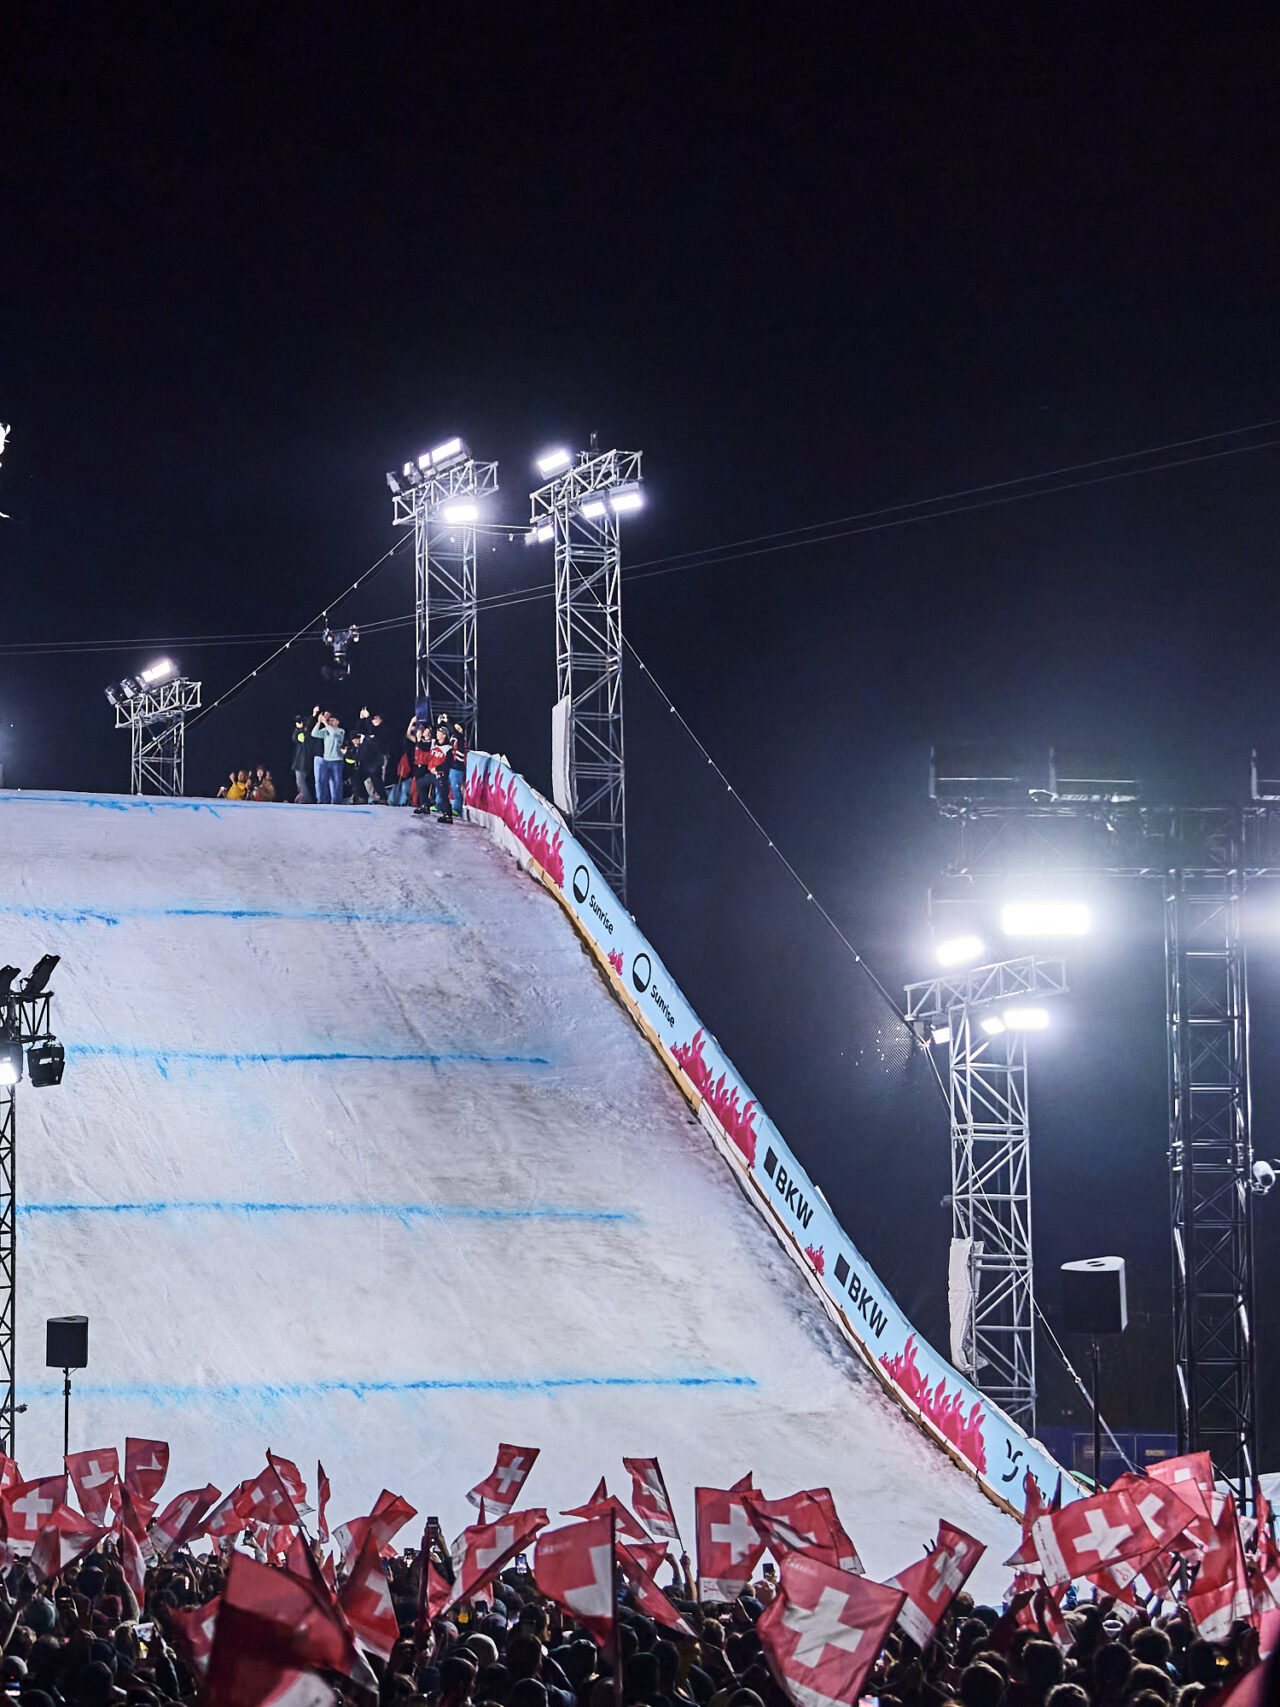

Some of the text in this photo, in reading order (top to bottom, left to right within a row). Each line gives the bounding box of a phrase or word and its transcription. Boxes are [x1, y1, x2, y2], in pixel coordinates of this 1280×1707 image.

[589, 894, 614, 935] Sunrise
[650, 985, 675, 1027] Sunrise
[774, 1167, 813, 1229] BKW
[847, 1271, 888, 1338] BKW
